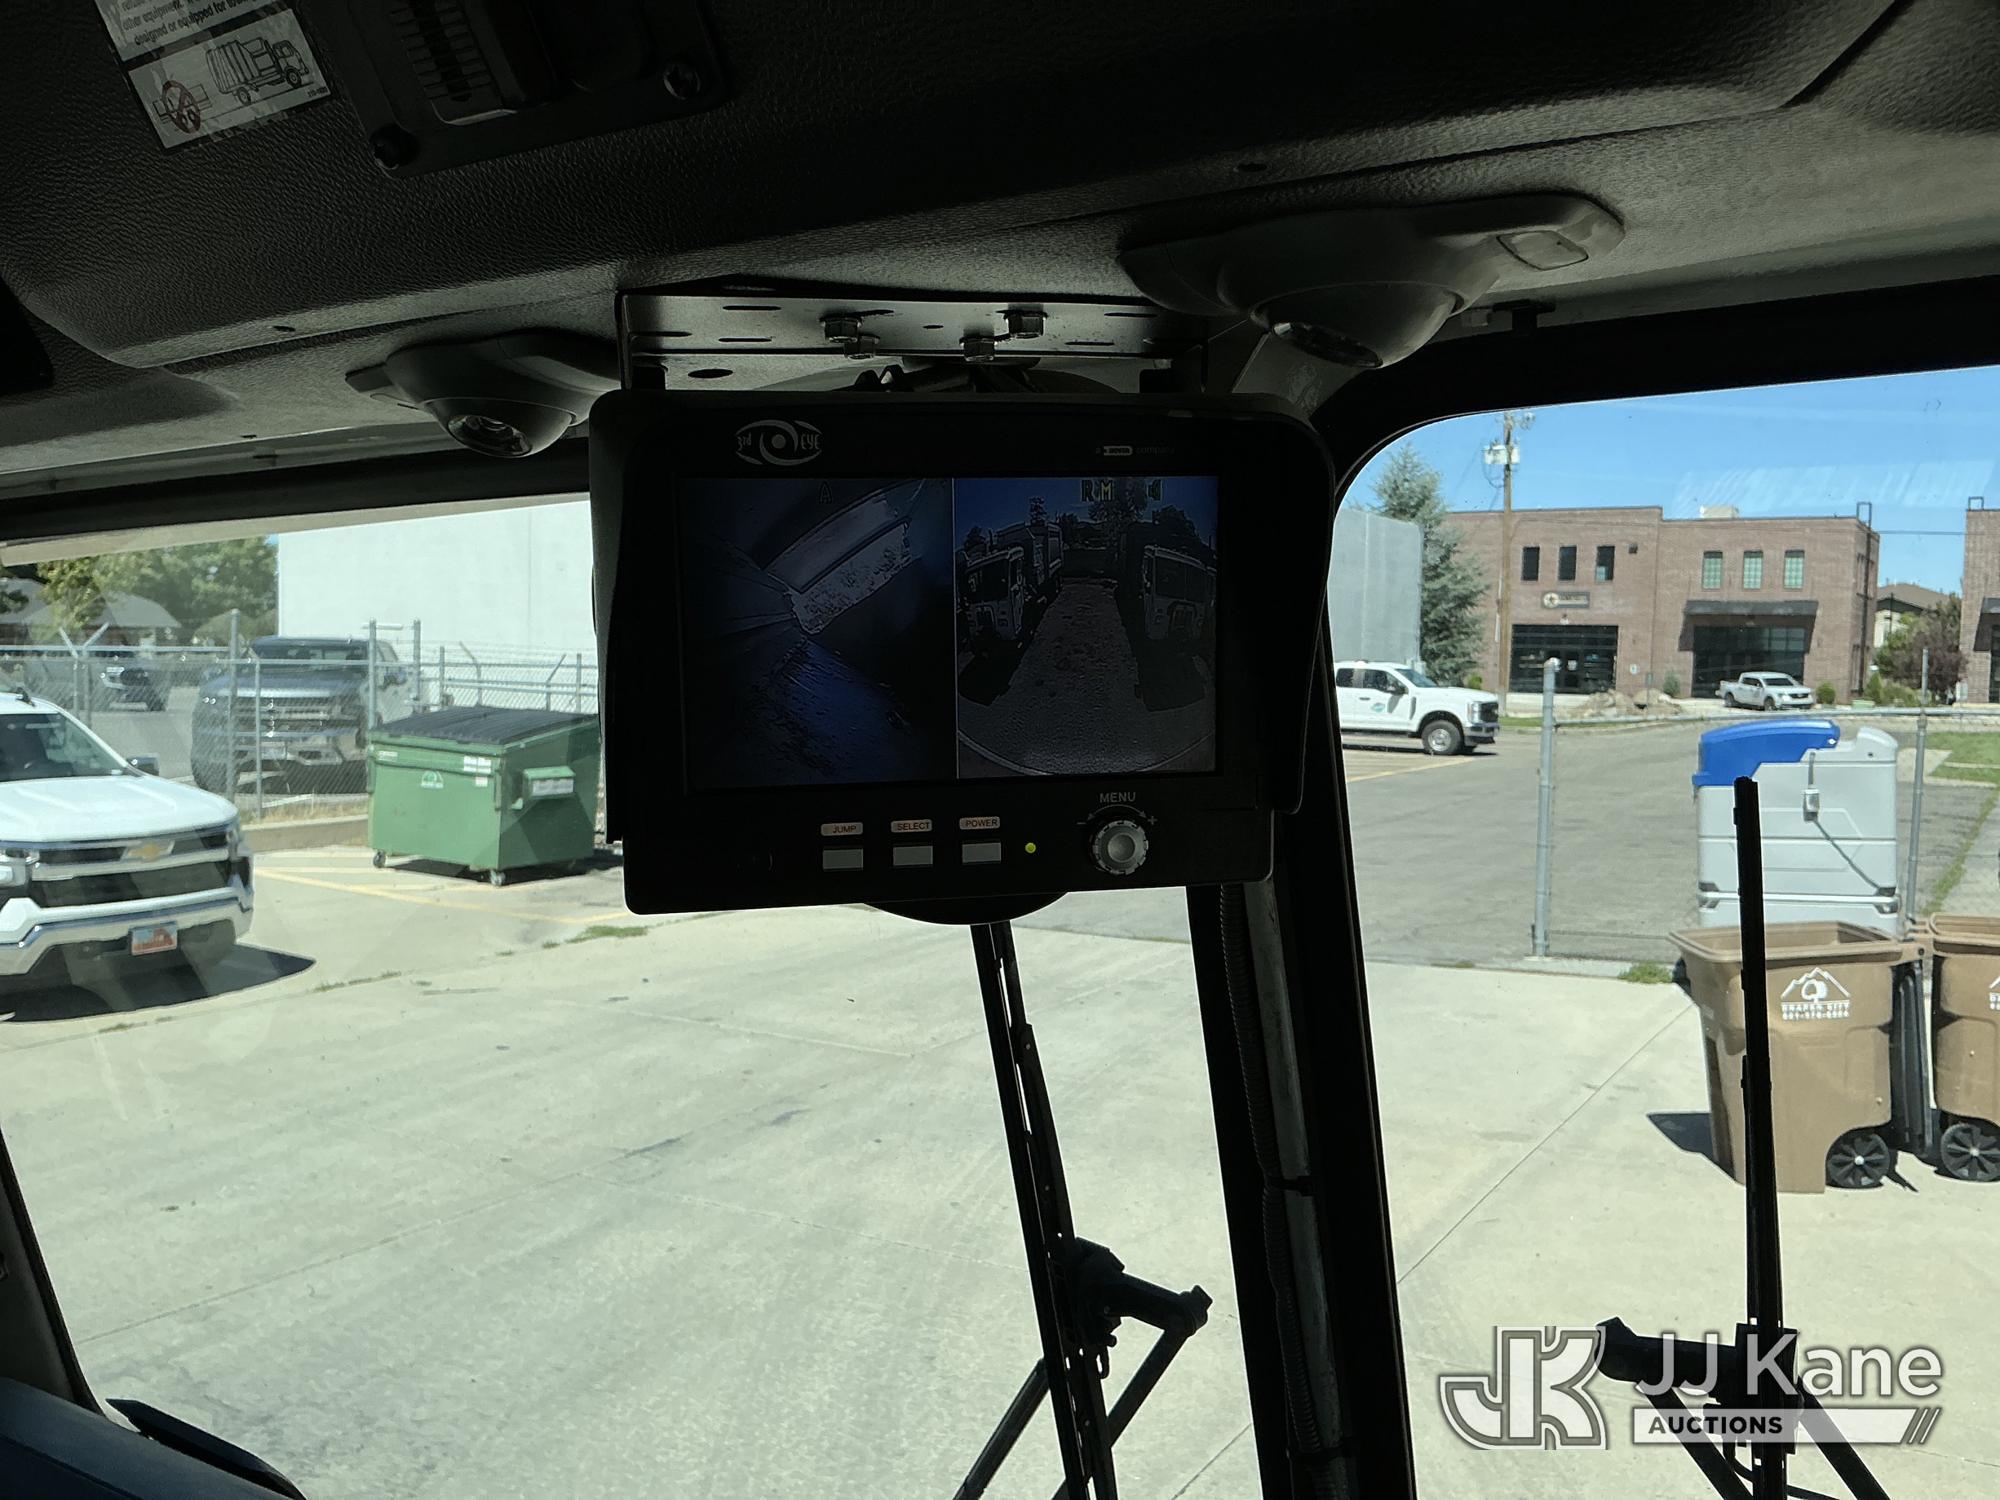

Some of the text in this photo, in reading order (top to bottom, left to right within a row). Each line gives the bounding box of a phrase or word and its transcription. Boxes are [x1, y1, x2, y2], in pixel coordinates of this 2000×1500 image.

[134, 23, 169, 46] designed
[177, 6, 214, 28] equipped
[214, 1, 226, 14] for
[737, 432, 820, 451] 3rd EYE
[1099, 791, 1137, 804] MENU
[832, 825, 857, 834] JUMP
[897, 821, 930, 832] SELECT
[965, 818, 998, 829] POWER
